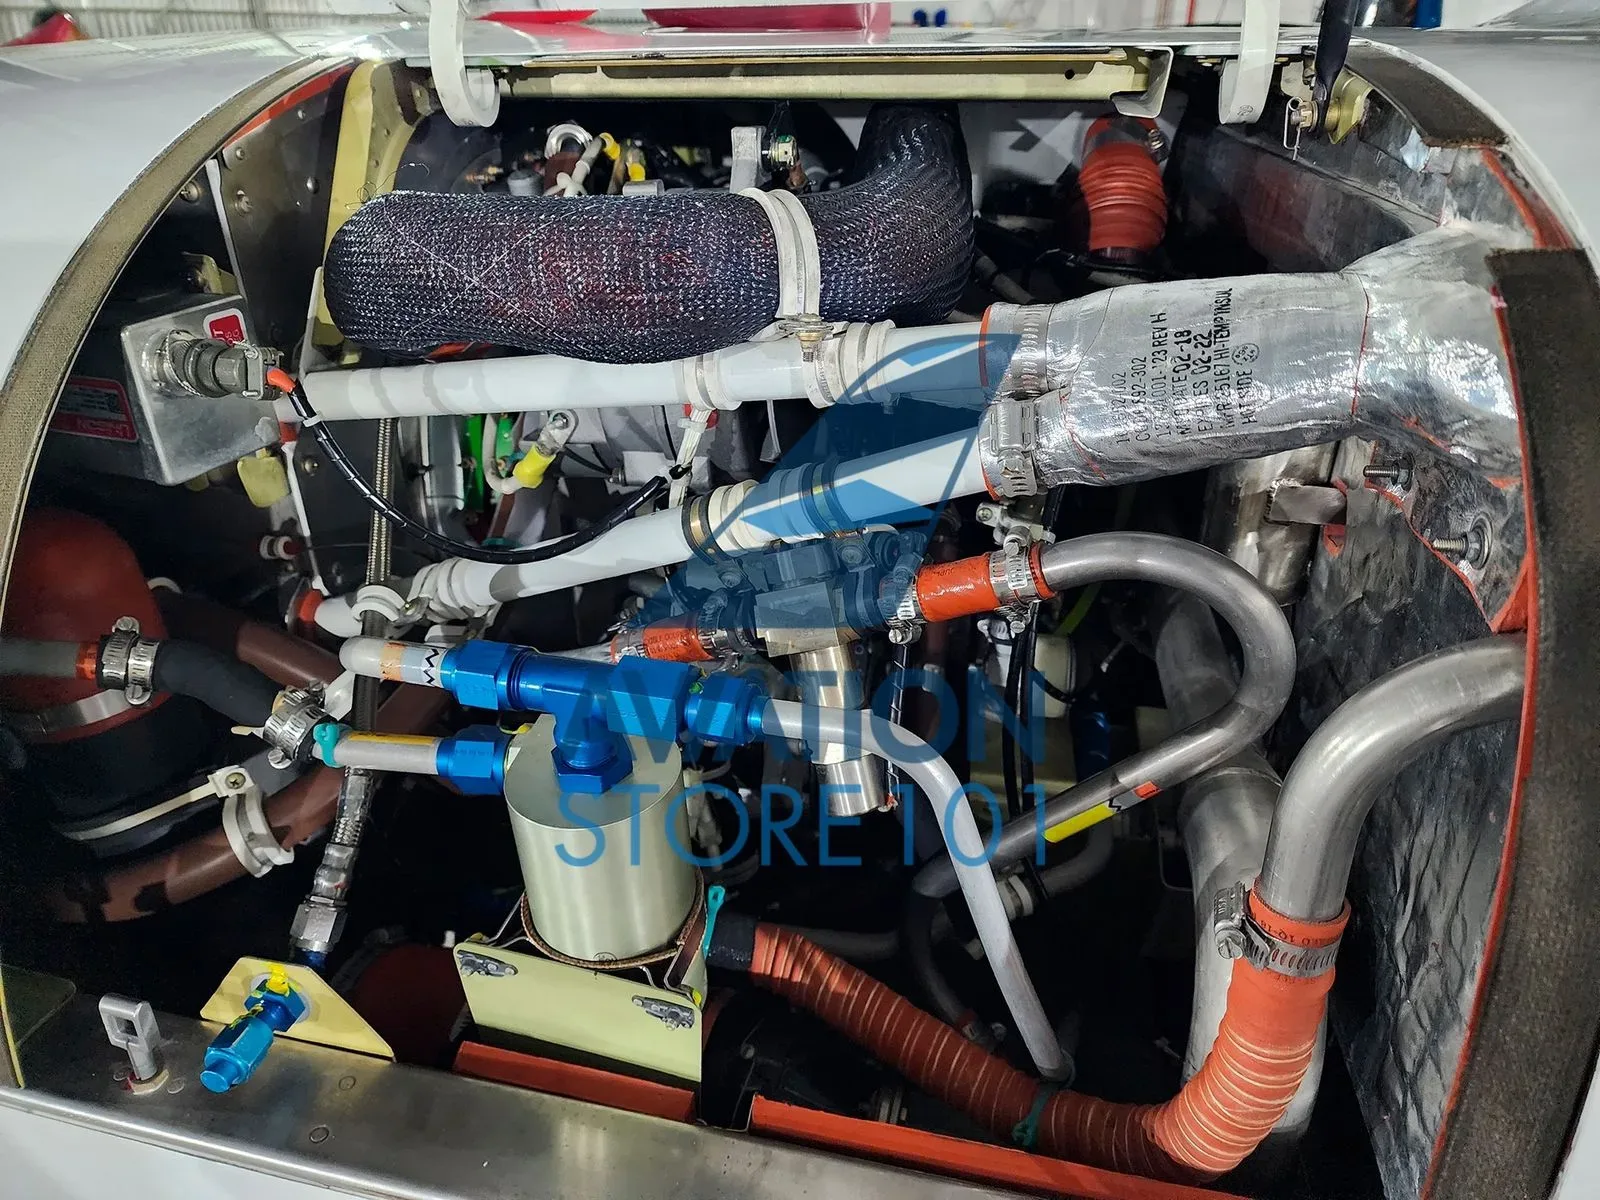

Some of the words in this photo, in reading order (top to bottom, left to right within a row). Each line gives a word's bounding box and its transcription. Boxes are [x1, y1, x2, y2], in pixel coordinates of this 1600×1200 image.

[1150, 312, 1167, 324] H
[1152, 327, 1168, 348] REV
[1173, 330, 1192, 374] 02-18
[1191, 329, 1213, 375] 02-22
